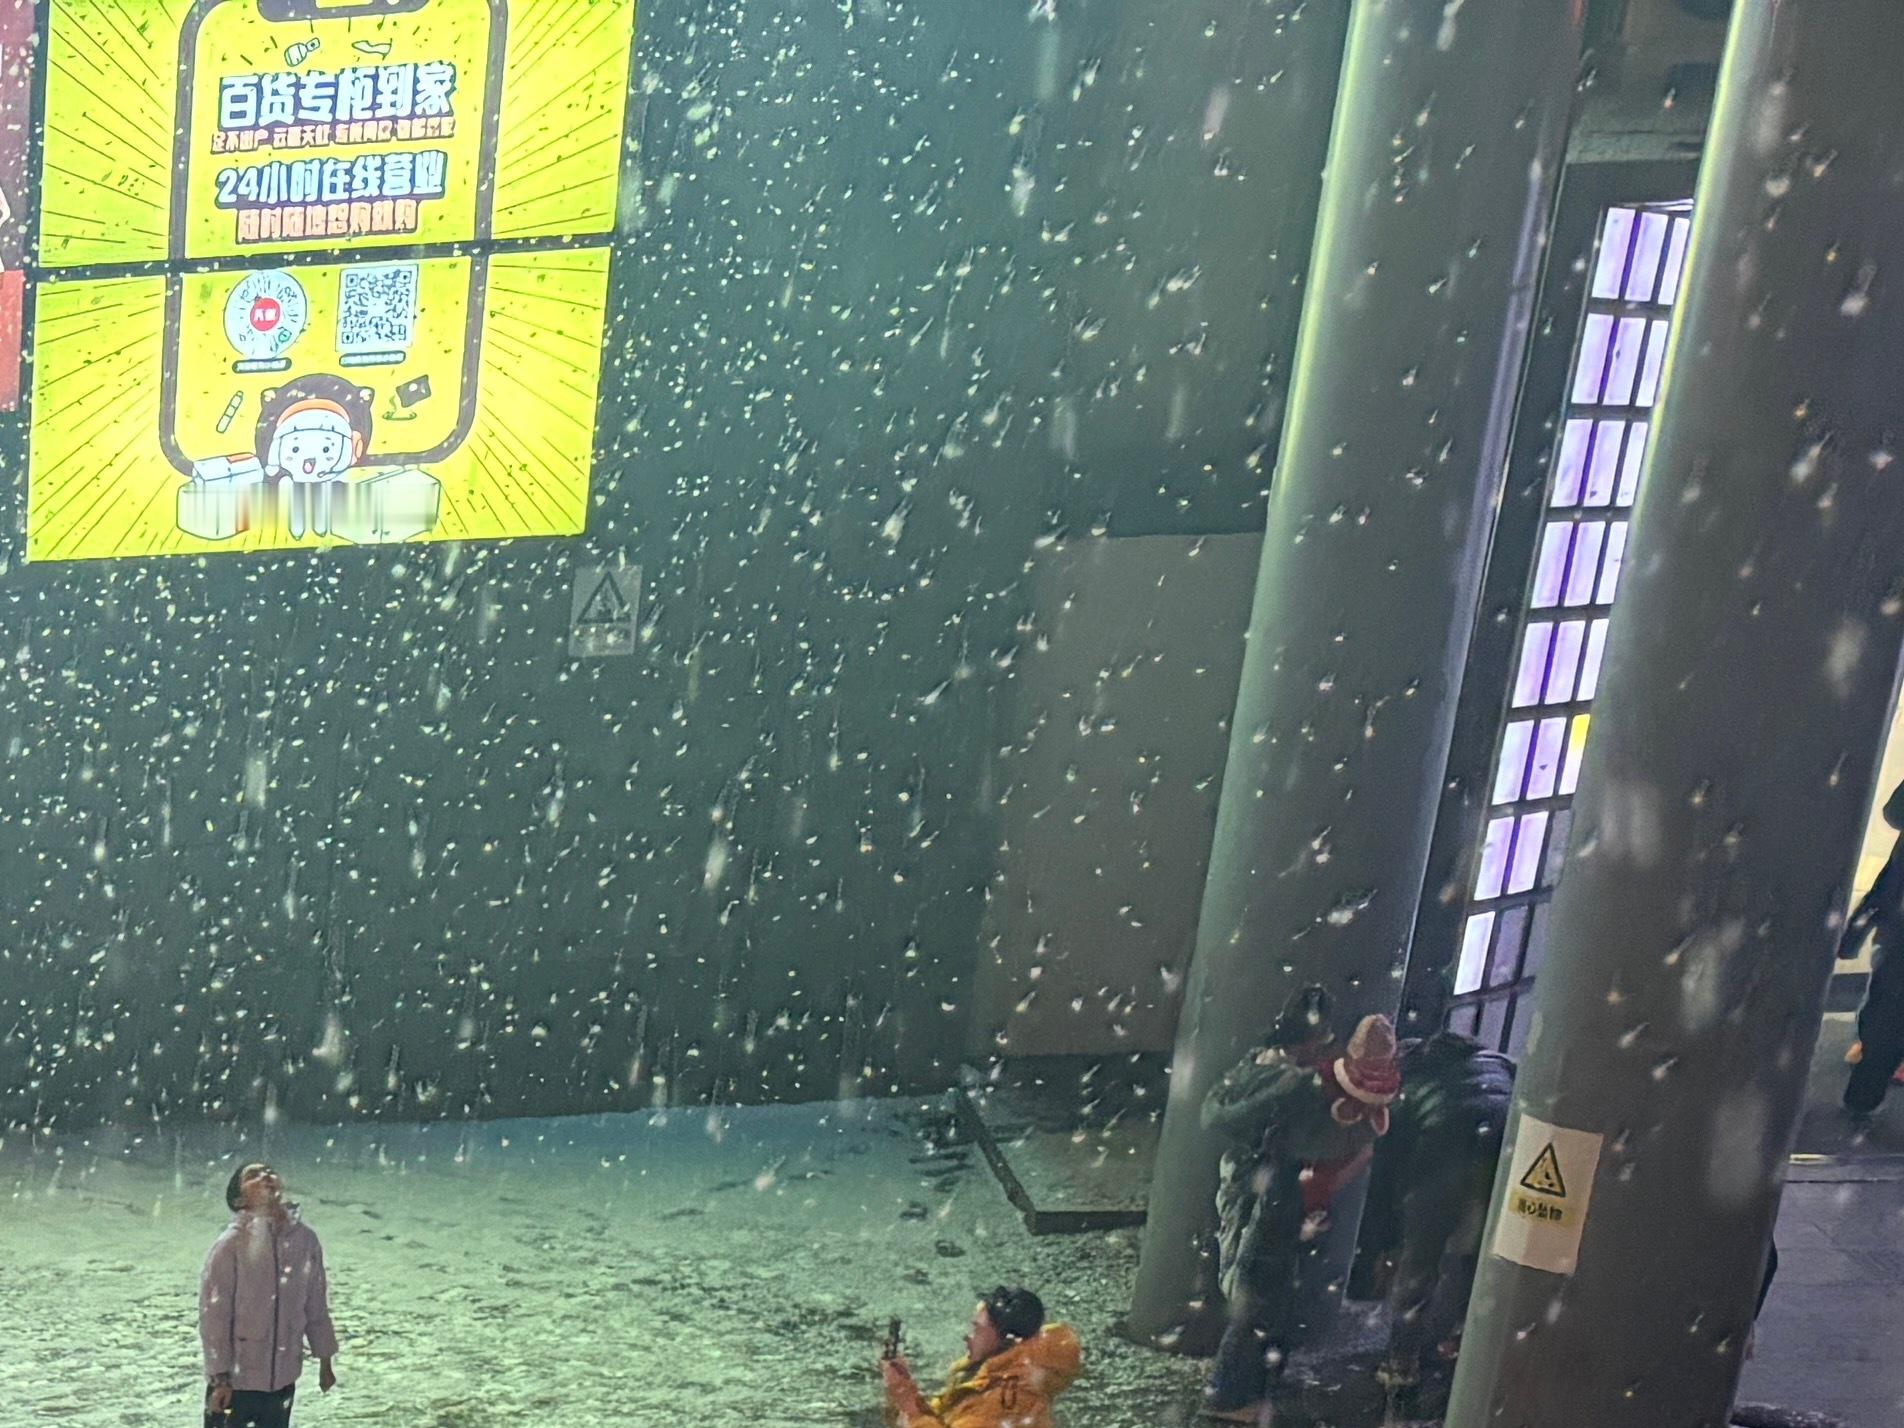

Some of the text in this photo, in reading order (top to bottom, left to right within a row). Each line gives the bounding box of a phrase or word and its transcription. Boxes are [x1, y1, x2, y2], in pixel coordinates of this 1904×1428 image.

[219, 61, 457, 129] 百货专柜到家
[217, 151, 446, 206] 24小时在线营业
